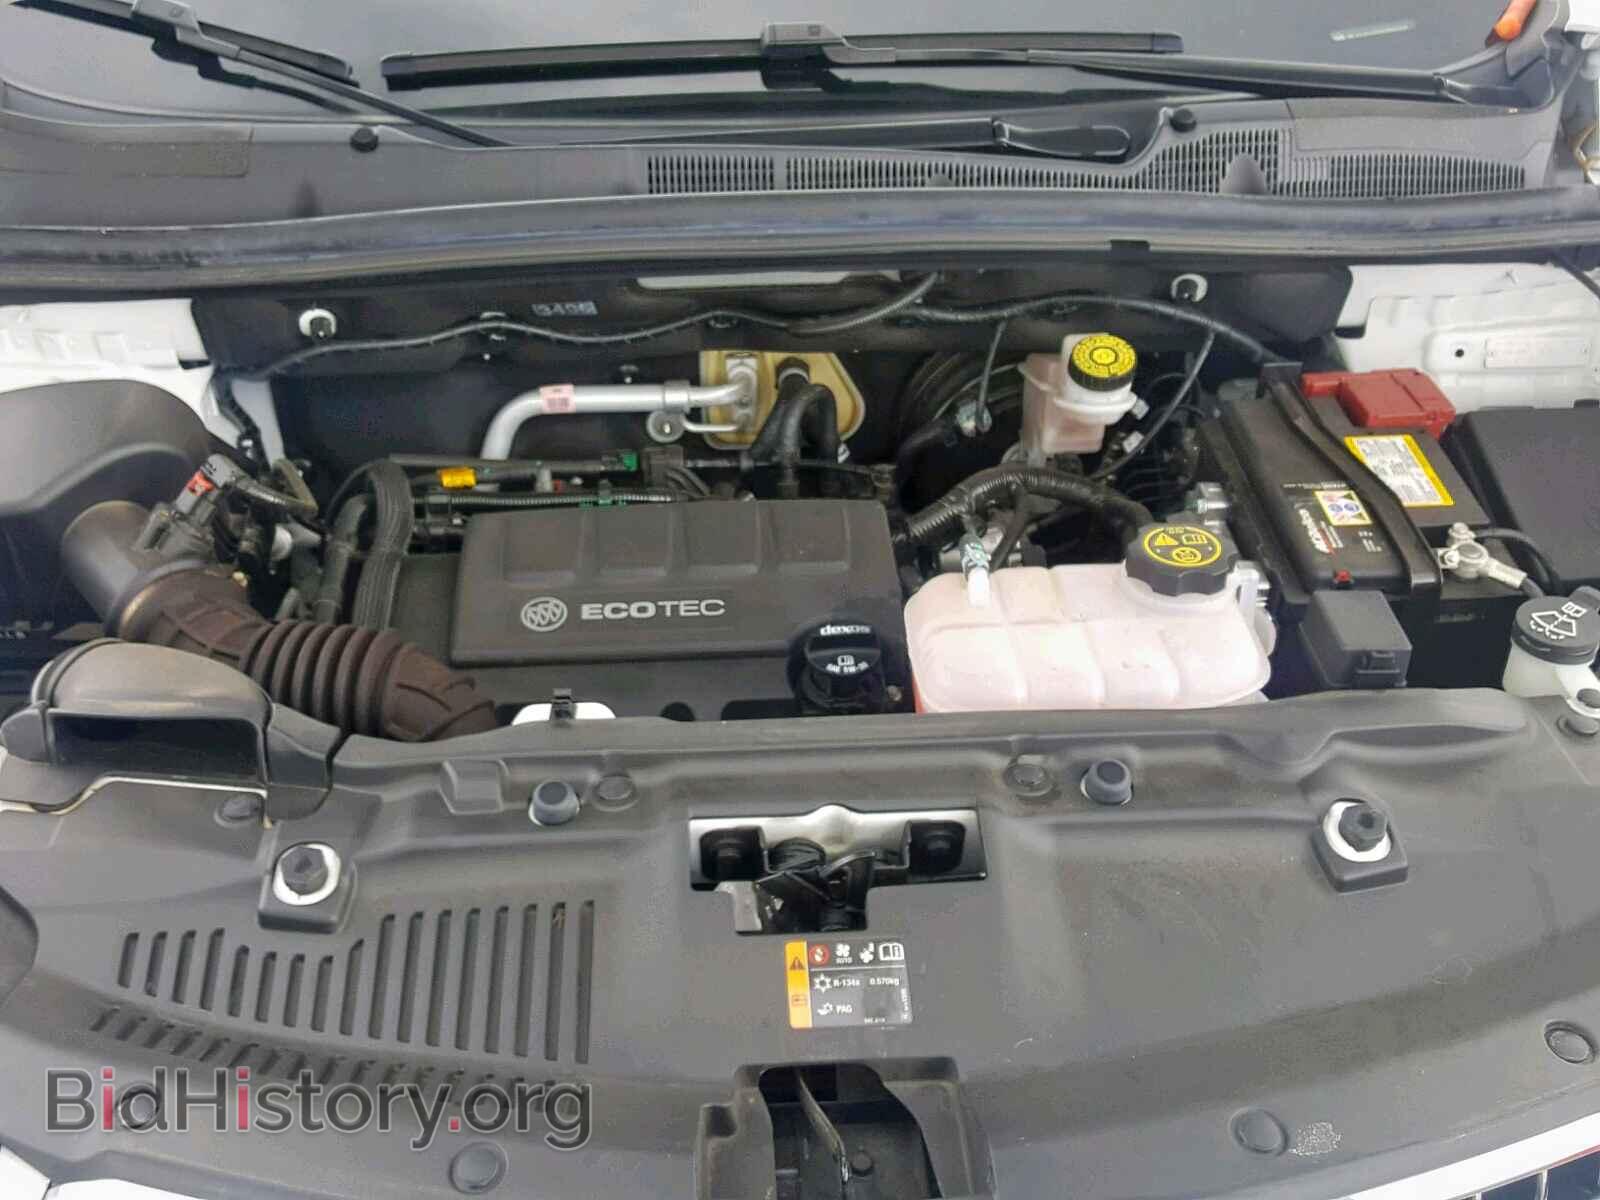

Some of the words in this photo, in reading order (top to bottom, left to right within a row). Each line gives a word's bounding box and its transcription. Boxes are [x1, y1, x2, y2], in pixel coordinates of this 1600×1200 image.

[581, 599, 726, 621] ECOTEC
[820, 624, 871, 636] dexos
[835, 1004, 853, 1014] PAG
